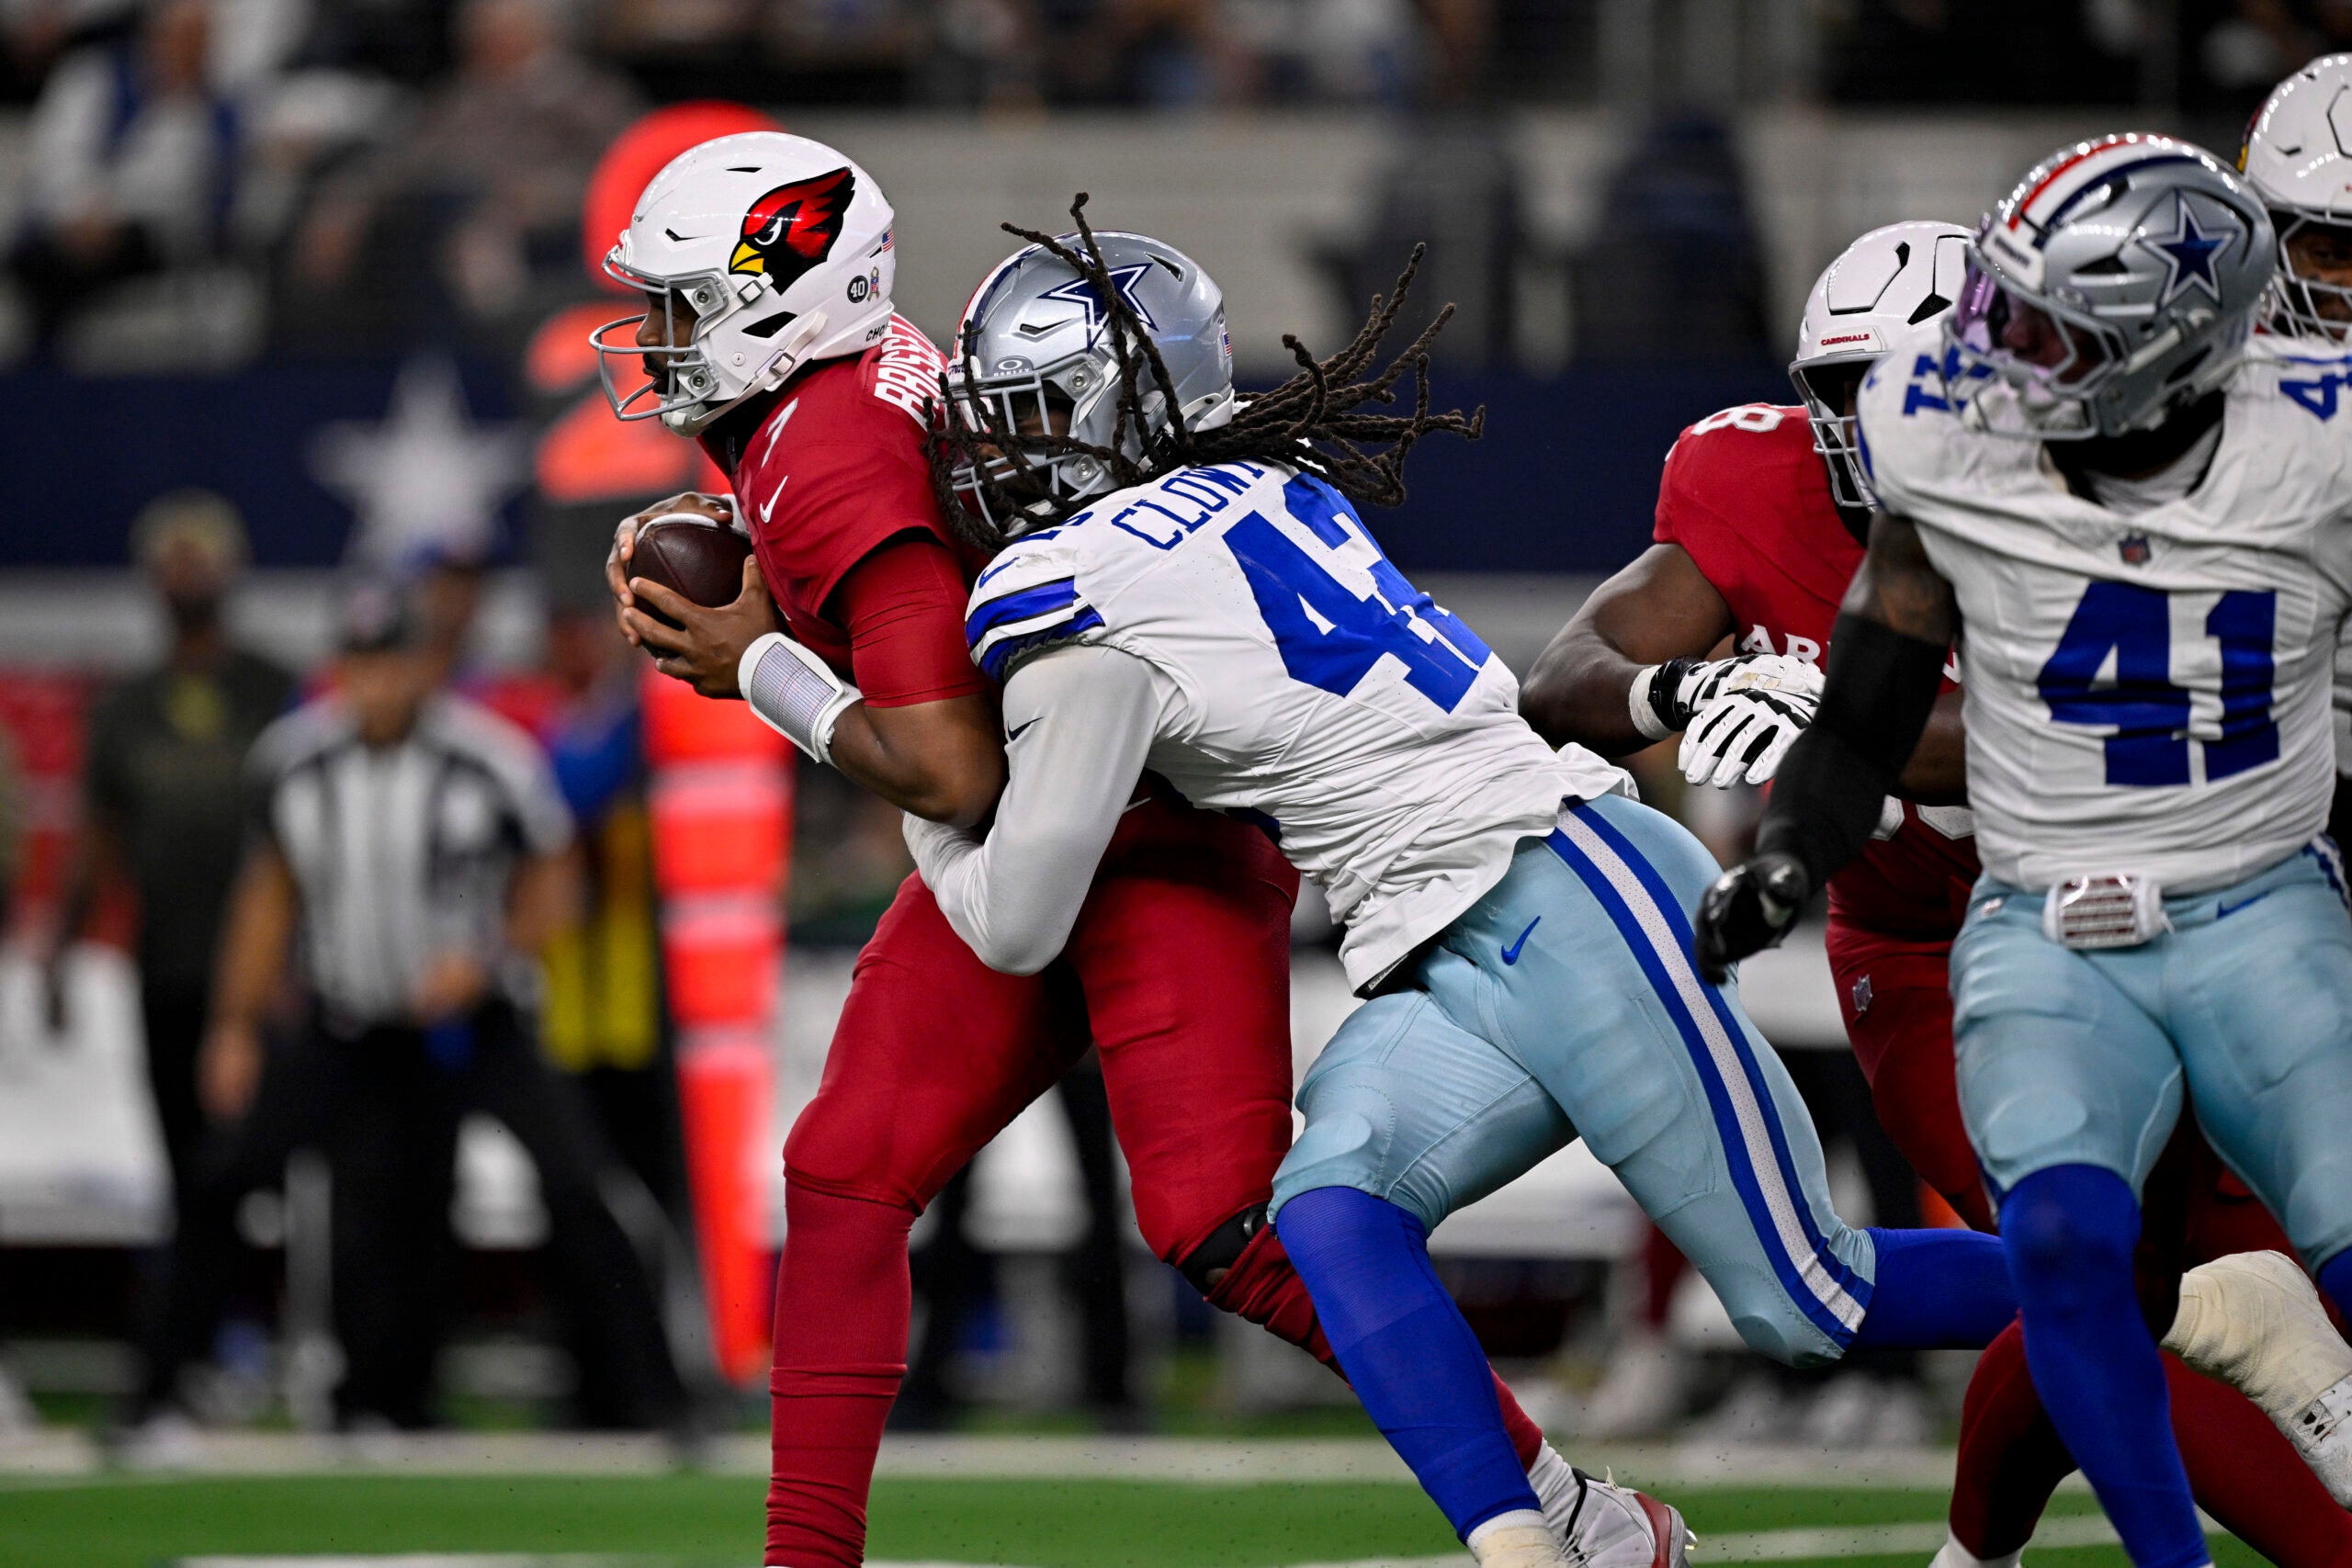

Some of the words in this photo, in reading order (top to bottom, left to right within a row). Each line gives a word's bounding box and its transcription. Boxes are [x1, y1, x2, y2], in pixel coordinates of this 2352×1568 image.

[850, 280, 865, 298] 40
[1821, 333, 1870, 345] CARDINALS
[761, 397, 798, 468] 7
[1222, 472, 1492, 715] 42
[2037, 581, 2280, 787] 41
